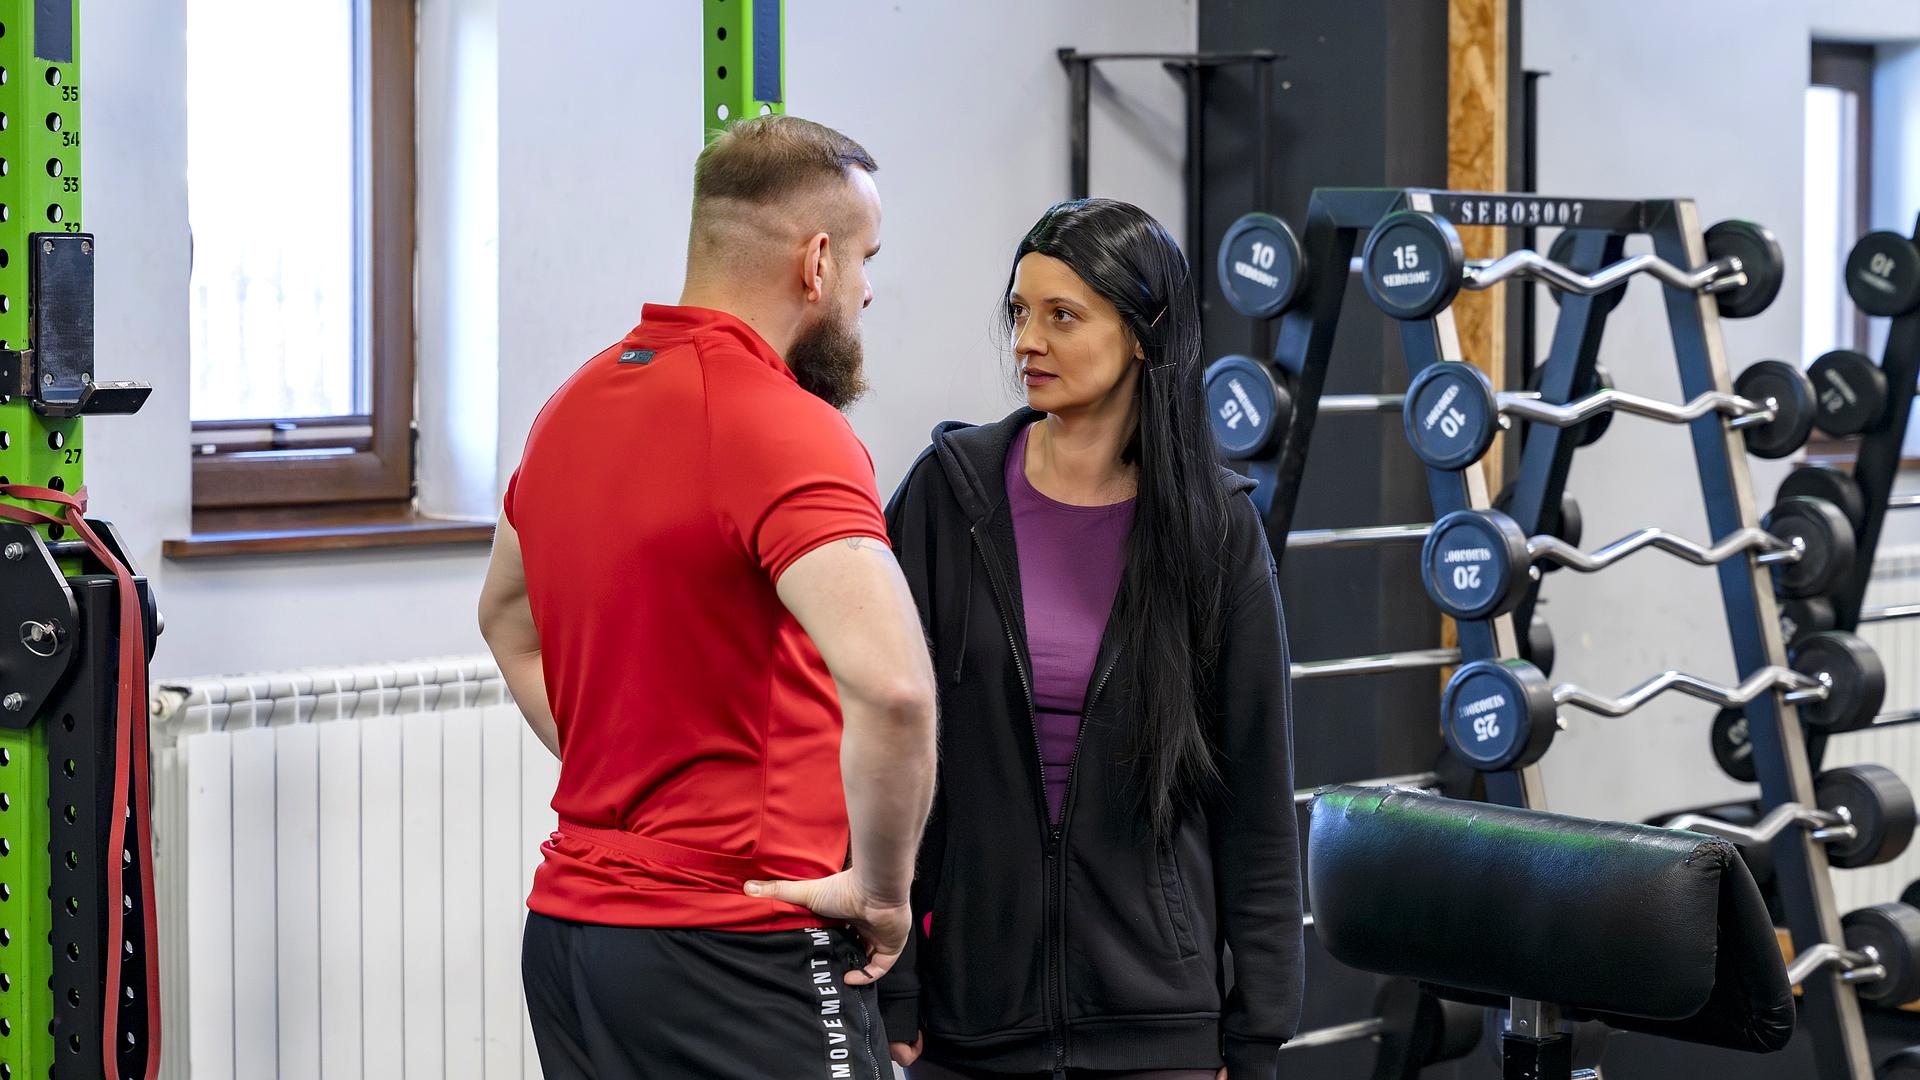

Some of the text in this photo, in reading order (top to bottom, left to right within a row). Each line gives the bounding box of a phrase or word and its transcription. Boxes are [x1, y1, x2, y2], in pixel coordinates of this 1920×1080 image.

[62, 86, 79, 102] 35
[63, 132, 80, 147] 34
[63, 177, 79, 192] 33
[1252, 242, 1276, 270] 10
[1392, 244, 1419, 270] 15
[1219, 398, 1244, 430] 15
[1440, 407, 1466, 439] 10
[64, 448, 82, 464] 27
[1452, 564, 1481, 590] 20
[1473, 712, 1500, 742] 25
[810, 958, 851, 1078] MOVEMENT
